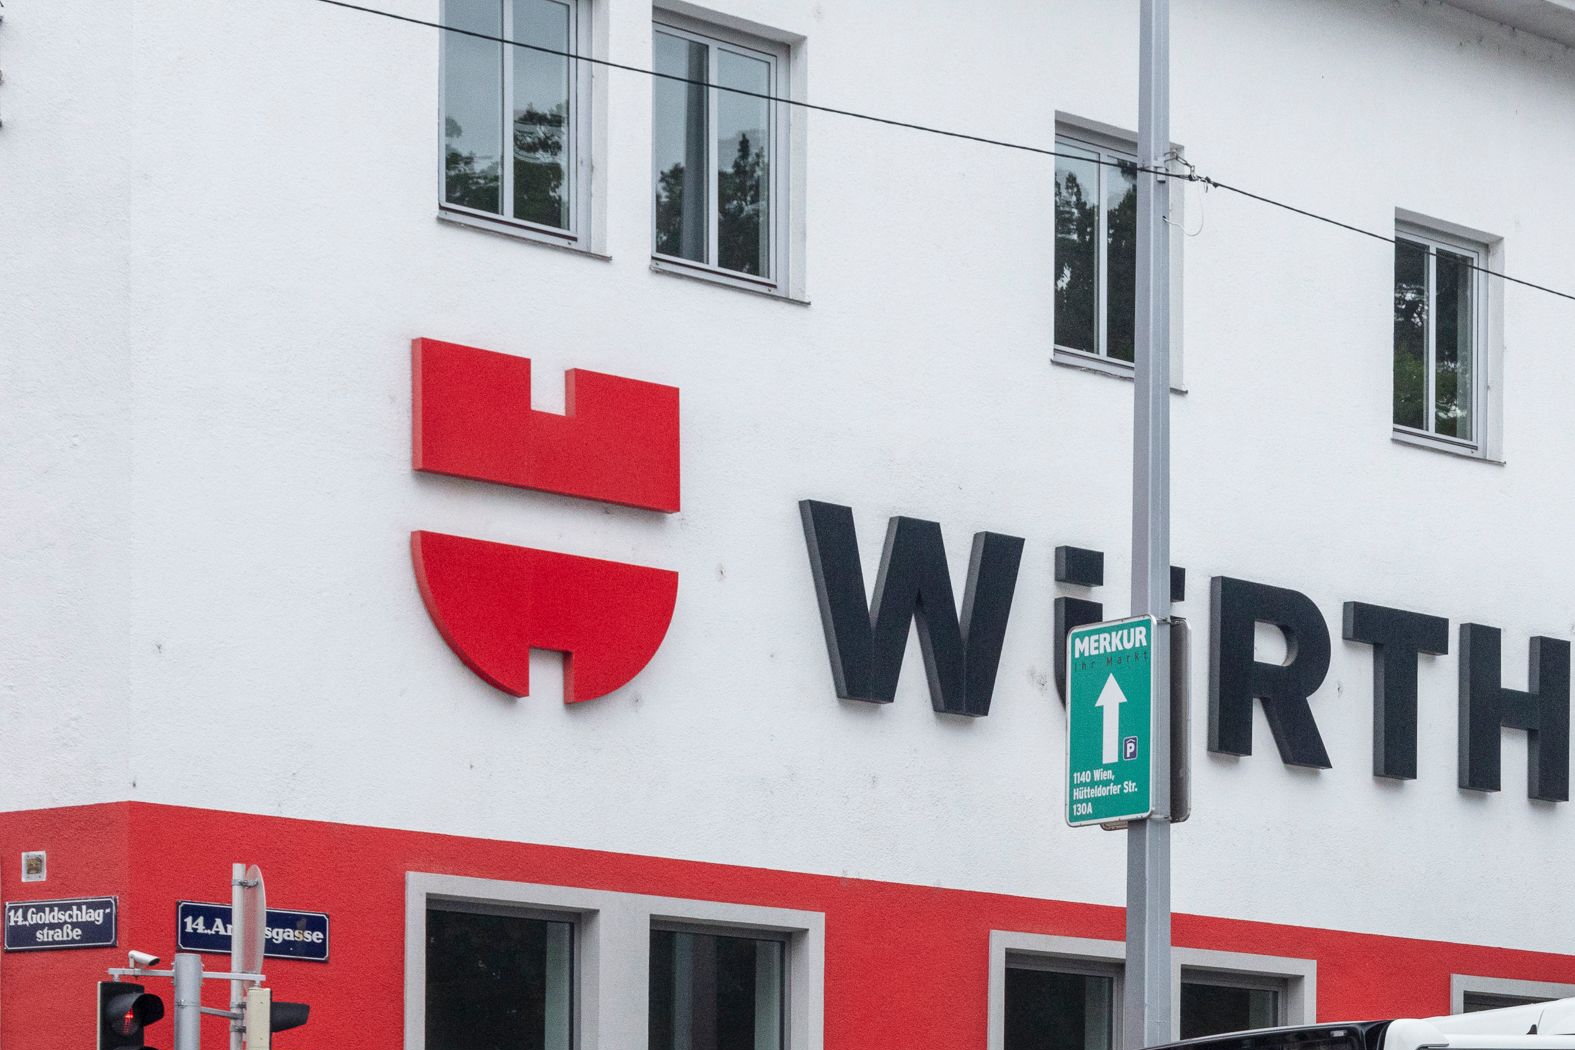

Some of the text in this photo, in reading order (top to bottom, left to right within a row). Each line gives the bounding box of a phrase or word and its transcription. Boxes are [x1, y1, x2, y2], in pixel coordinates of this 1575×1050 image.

[1074, 626, 1148, 659] MERKUR
[1106, 651, 1149, 666] Markt
[1073, 768, 1115, 785] 1140 Wien,
[1073, 780, 1138, 800] Hütteldorfer Str.
[1072, 802, 1093, 817] 130A
[36, 924, 82, 942] straße
